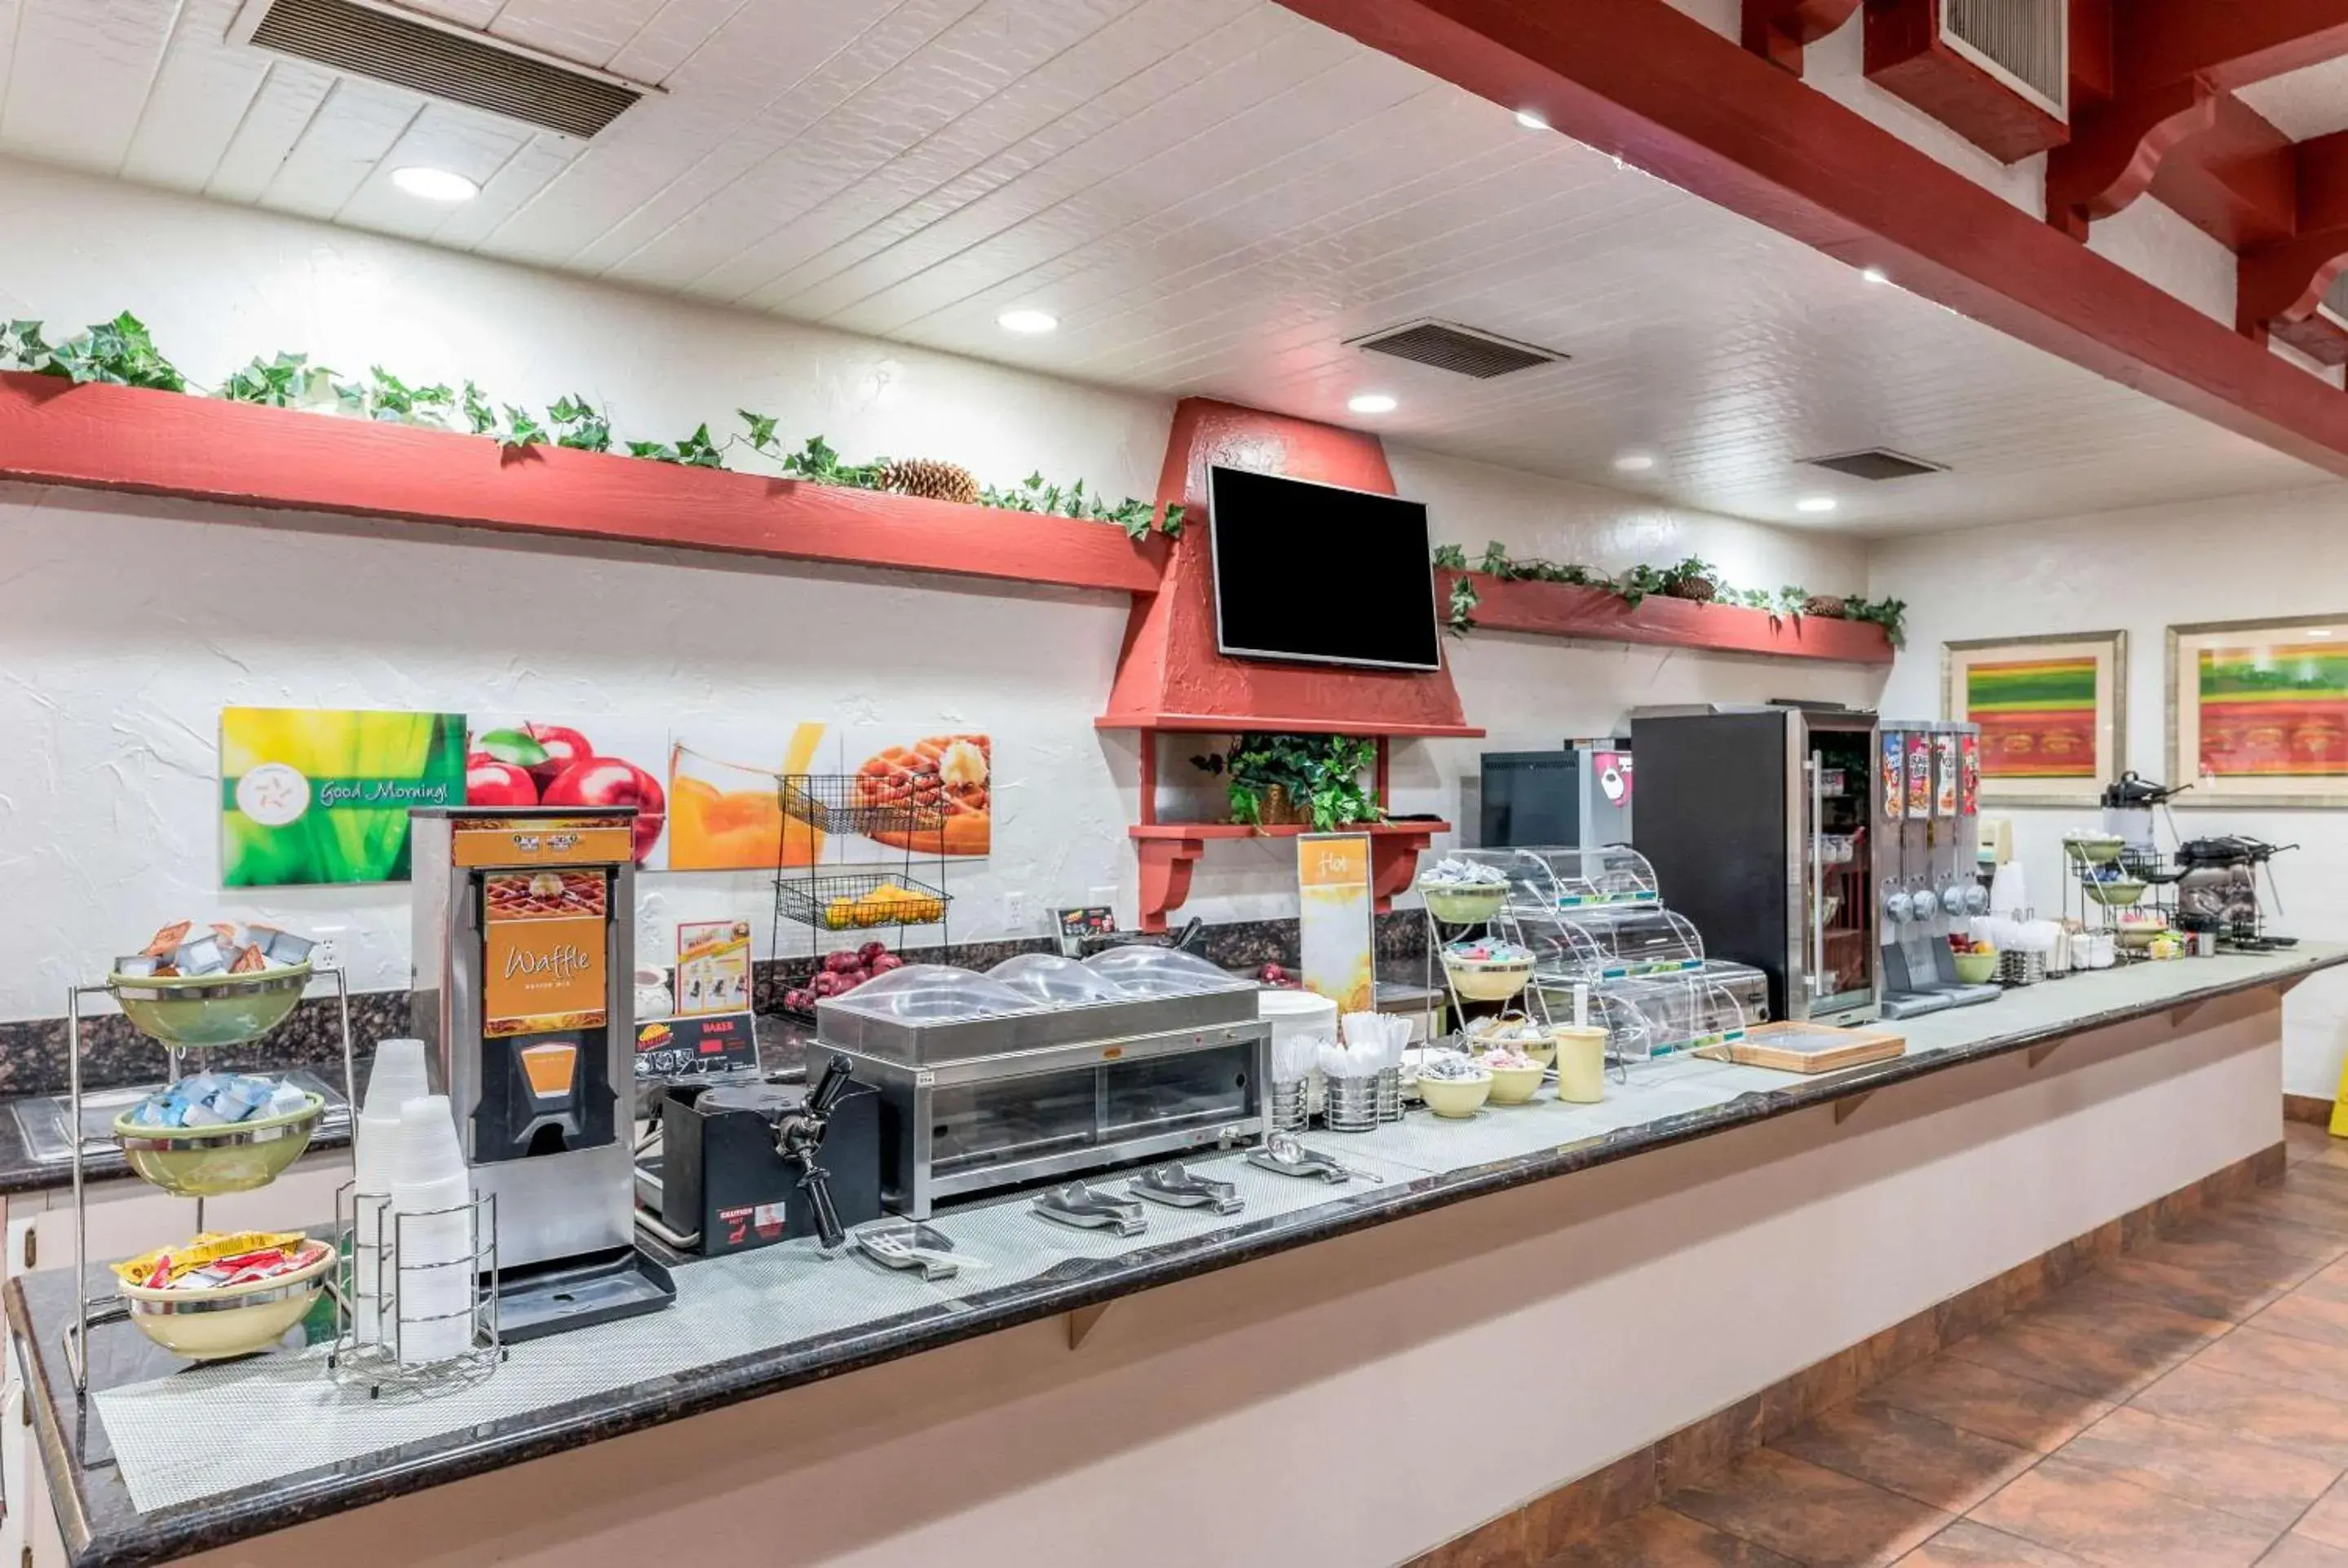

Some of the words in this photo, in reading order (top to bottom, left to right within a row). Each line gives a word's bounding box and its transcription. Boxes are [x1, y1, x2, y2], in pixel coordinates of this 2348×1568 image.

[321, 780, 361, 806] Good
[1318, 850, 1348, 877] Hot
[504, 944, 590, 978] Waffle
[719, 1207, 754, 1220] CAUTION
